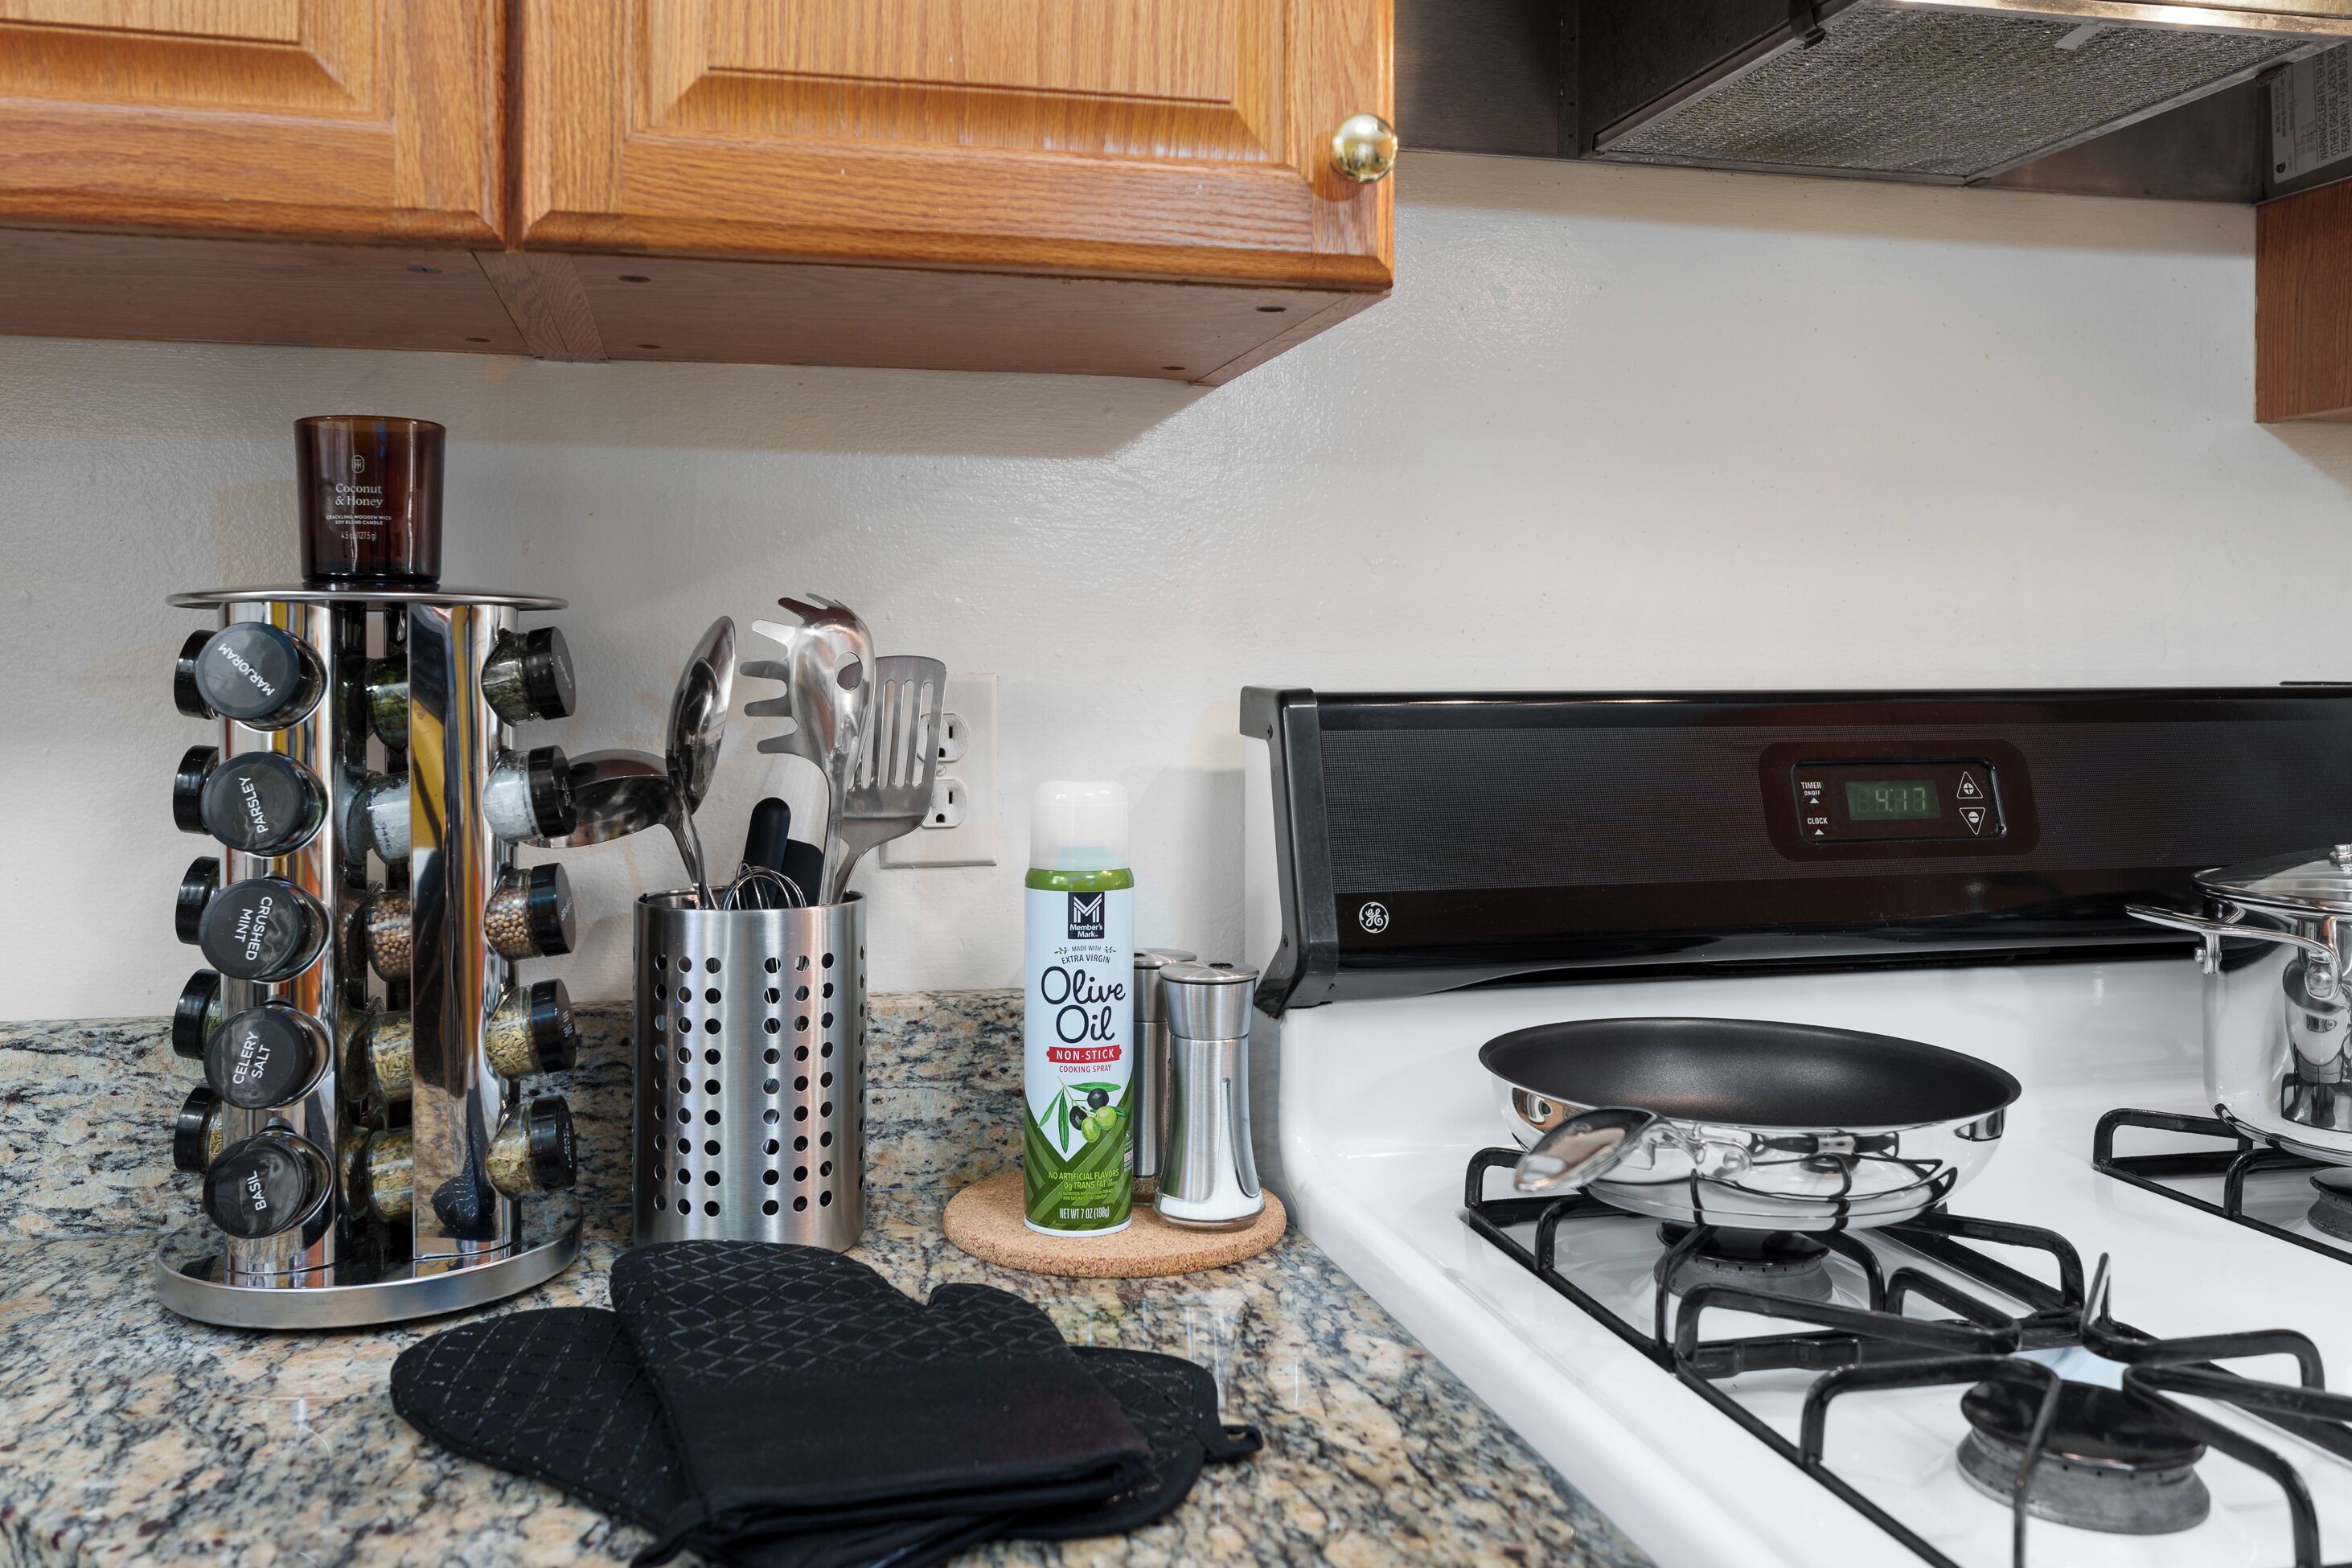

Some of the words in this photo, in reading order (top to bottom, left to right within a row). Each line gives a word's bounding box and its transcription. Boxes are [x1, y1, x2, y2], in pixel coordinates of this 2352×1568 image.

[2316, 67, 2326, 95] FILTER
[2327, 67, 2338, 95] LADEN
[2338, 79, 2348, 97] USE
[2329, 95, 2339, 129] GREASE
[2317, 96, 2329, 162] WARNING-CLEAN
[2330, 129, 2340, 156] OTHER
[335, 482, 383, 494] Coconut
[335, 495, 344, 506] &
[347, 495, 384, 508] Honey
[217, 643, 276, 696] MARJORAM
[1800, 782, 1821, 790] TIMER
[1875, 787, 1926, 811] 4:17
[239, 777, 269, 834] PARSLEY
[1807, 817, 1828, 825] CLOCK
[234, 909, 254, 942] MINT
[245, 897, 273, 961] CRUSHED
[1069, 923, 1103, 931] Member's
[1061, 954, 1084, 965] EXTRA
[1086, 954, 1110, 964] VIRGIN
[1041, 966, 1126, 1005] Olive
[1056, 1004, 1115, 1044] Oil
[232, 1031, 258, 1085] CELERY
[251, 1045, 271, 1079] SALT
[1056, 1048, 1114, 1061] NON-STICK
[1049, 1172, 1058, 1180] NO
[1058, 1172, 1094, 1180] ARTIFICIAL
[1094, 1168, 1119, 1179] FLAVORS
[1064, 1181, 1073, 1191] 0g
[1073, 1181, 1094, 1189] TRANS
[1096, 1180, 1106, 1188] FAT
[247, 1171, 268, 1211] BASIL
[1060, 1208, 1069, 1219] NET
[1070, 1208, 1080, 1219] WT
[1081, 1208, 1085, 1219] 7
[1086, 1208, 1093, 1219] OZ
